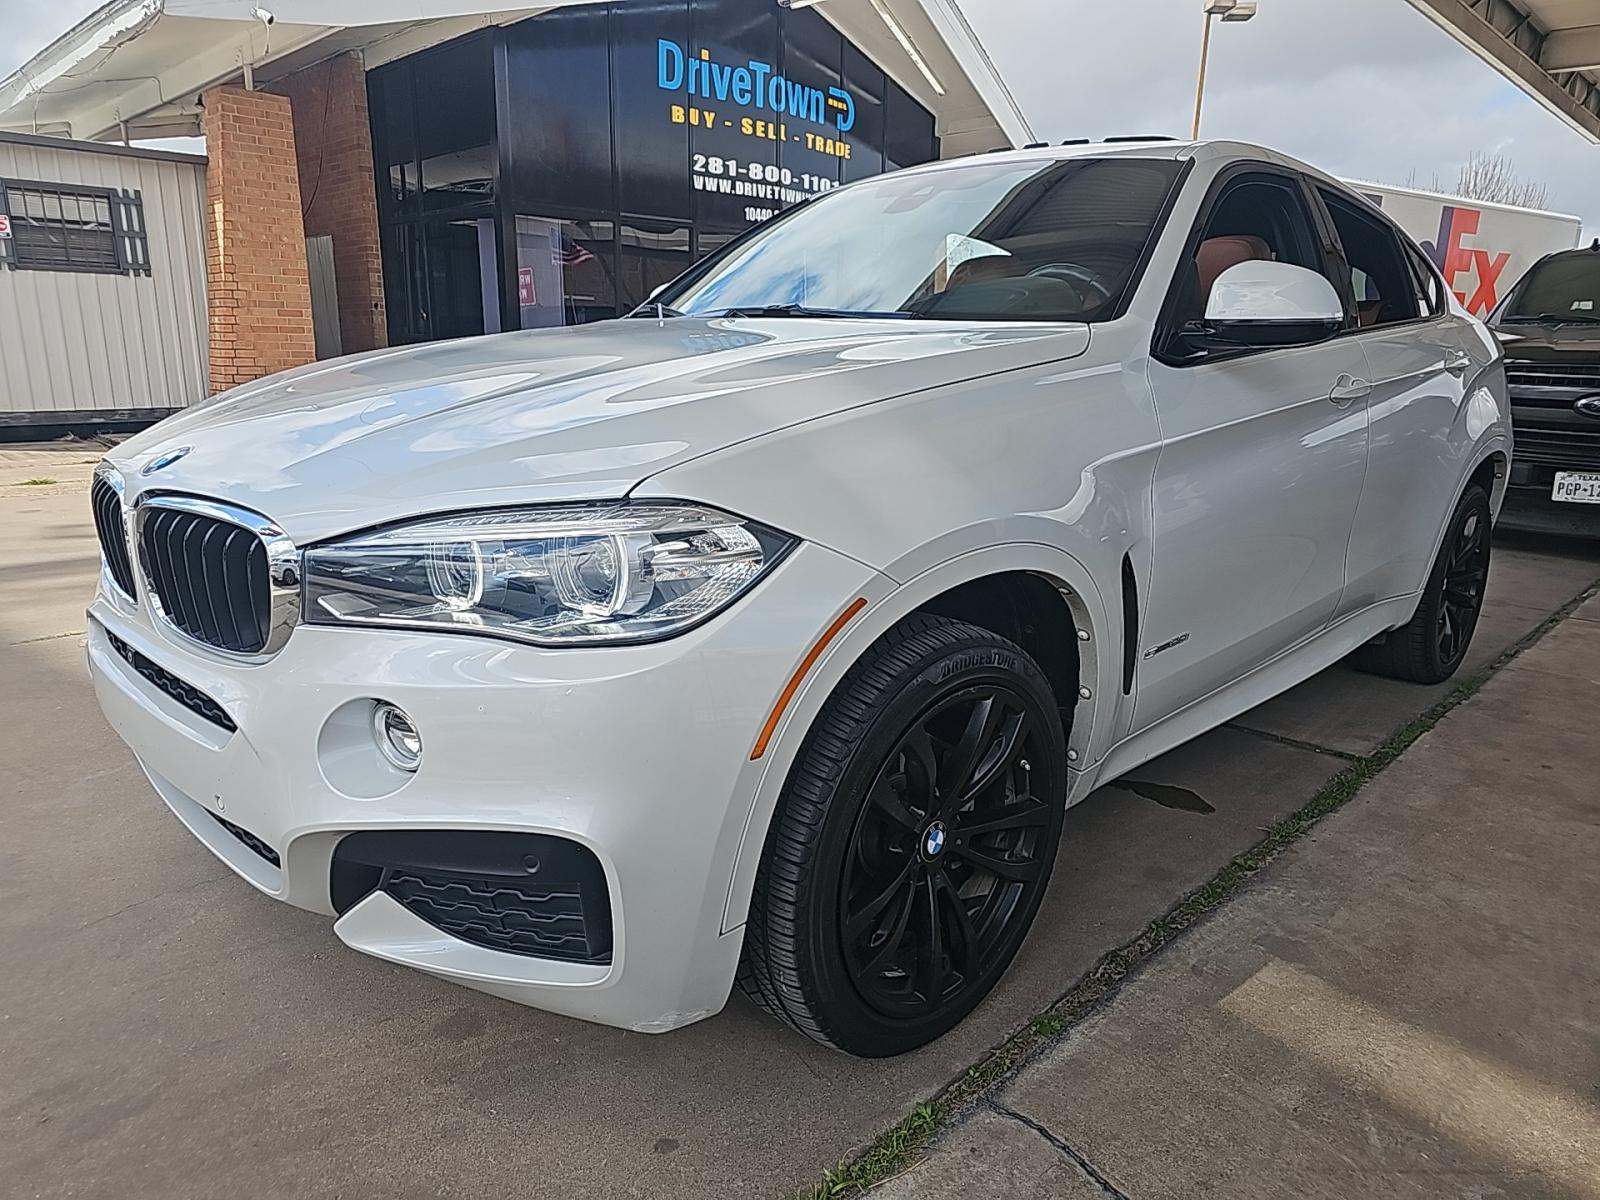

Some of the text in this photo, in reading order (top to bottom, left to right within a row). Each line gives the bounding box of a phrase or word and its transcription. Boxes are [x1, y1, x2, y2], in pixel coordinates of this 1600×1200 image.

[658, 39, 825, 124] DriveTown
[671, 105, 716, 129] BUY
[741, 117, 787, 141] SELL
[805, 132, 851, 159] TRADE
